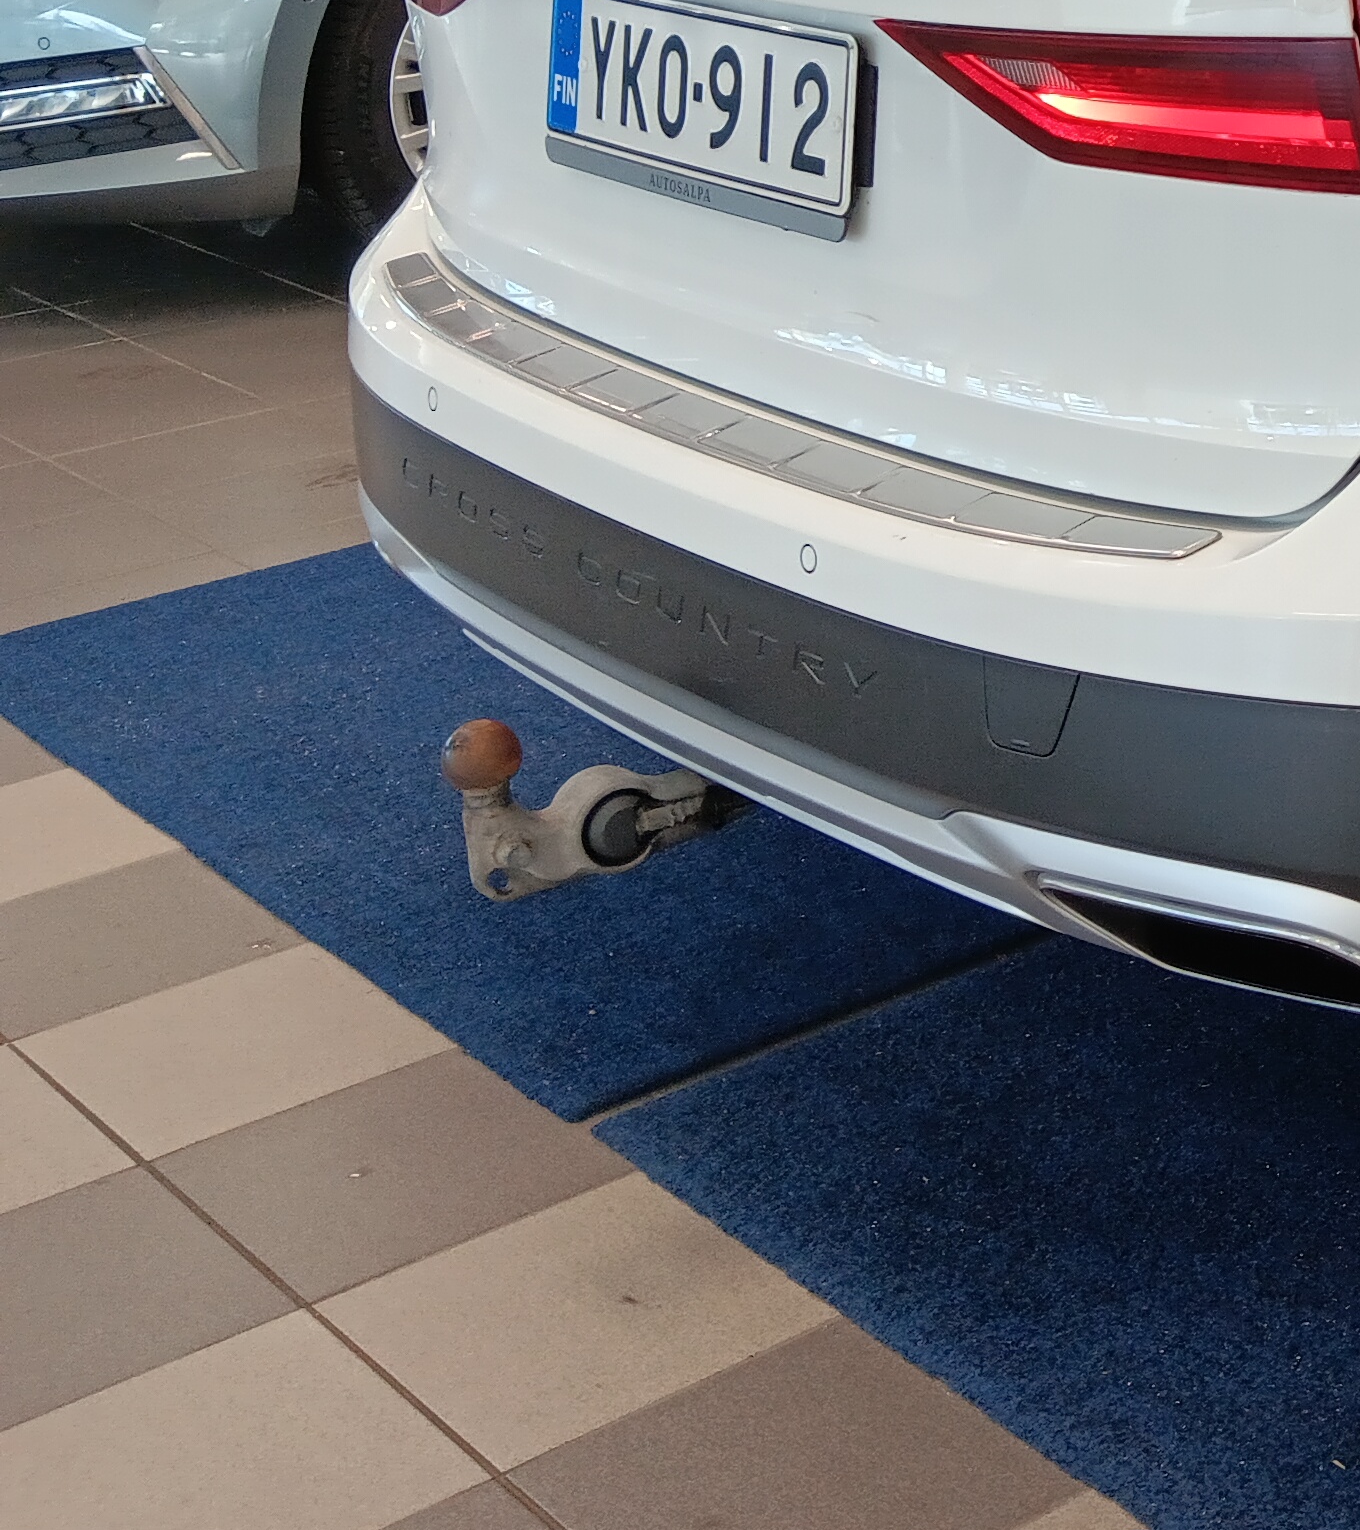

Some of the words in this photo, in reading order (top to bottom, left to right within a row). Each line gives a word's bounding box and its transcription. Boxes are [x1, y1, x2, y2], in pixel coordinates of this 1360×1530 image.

[553, 73, 577, 106] FIN
[591, 16, 829, 175] YKO-912
[649, 173, 711, 203] AUTOSALPA
